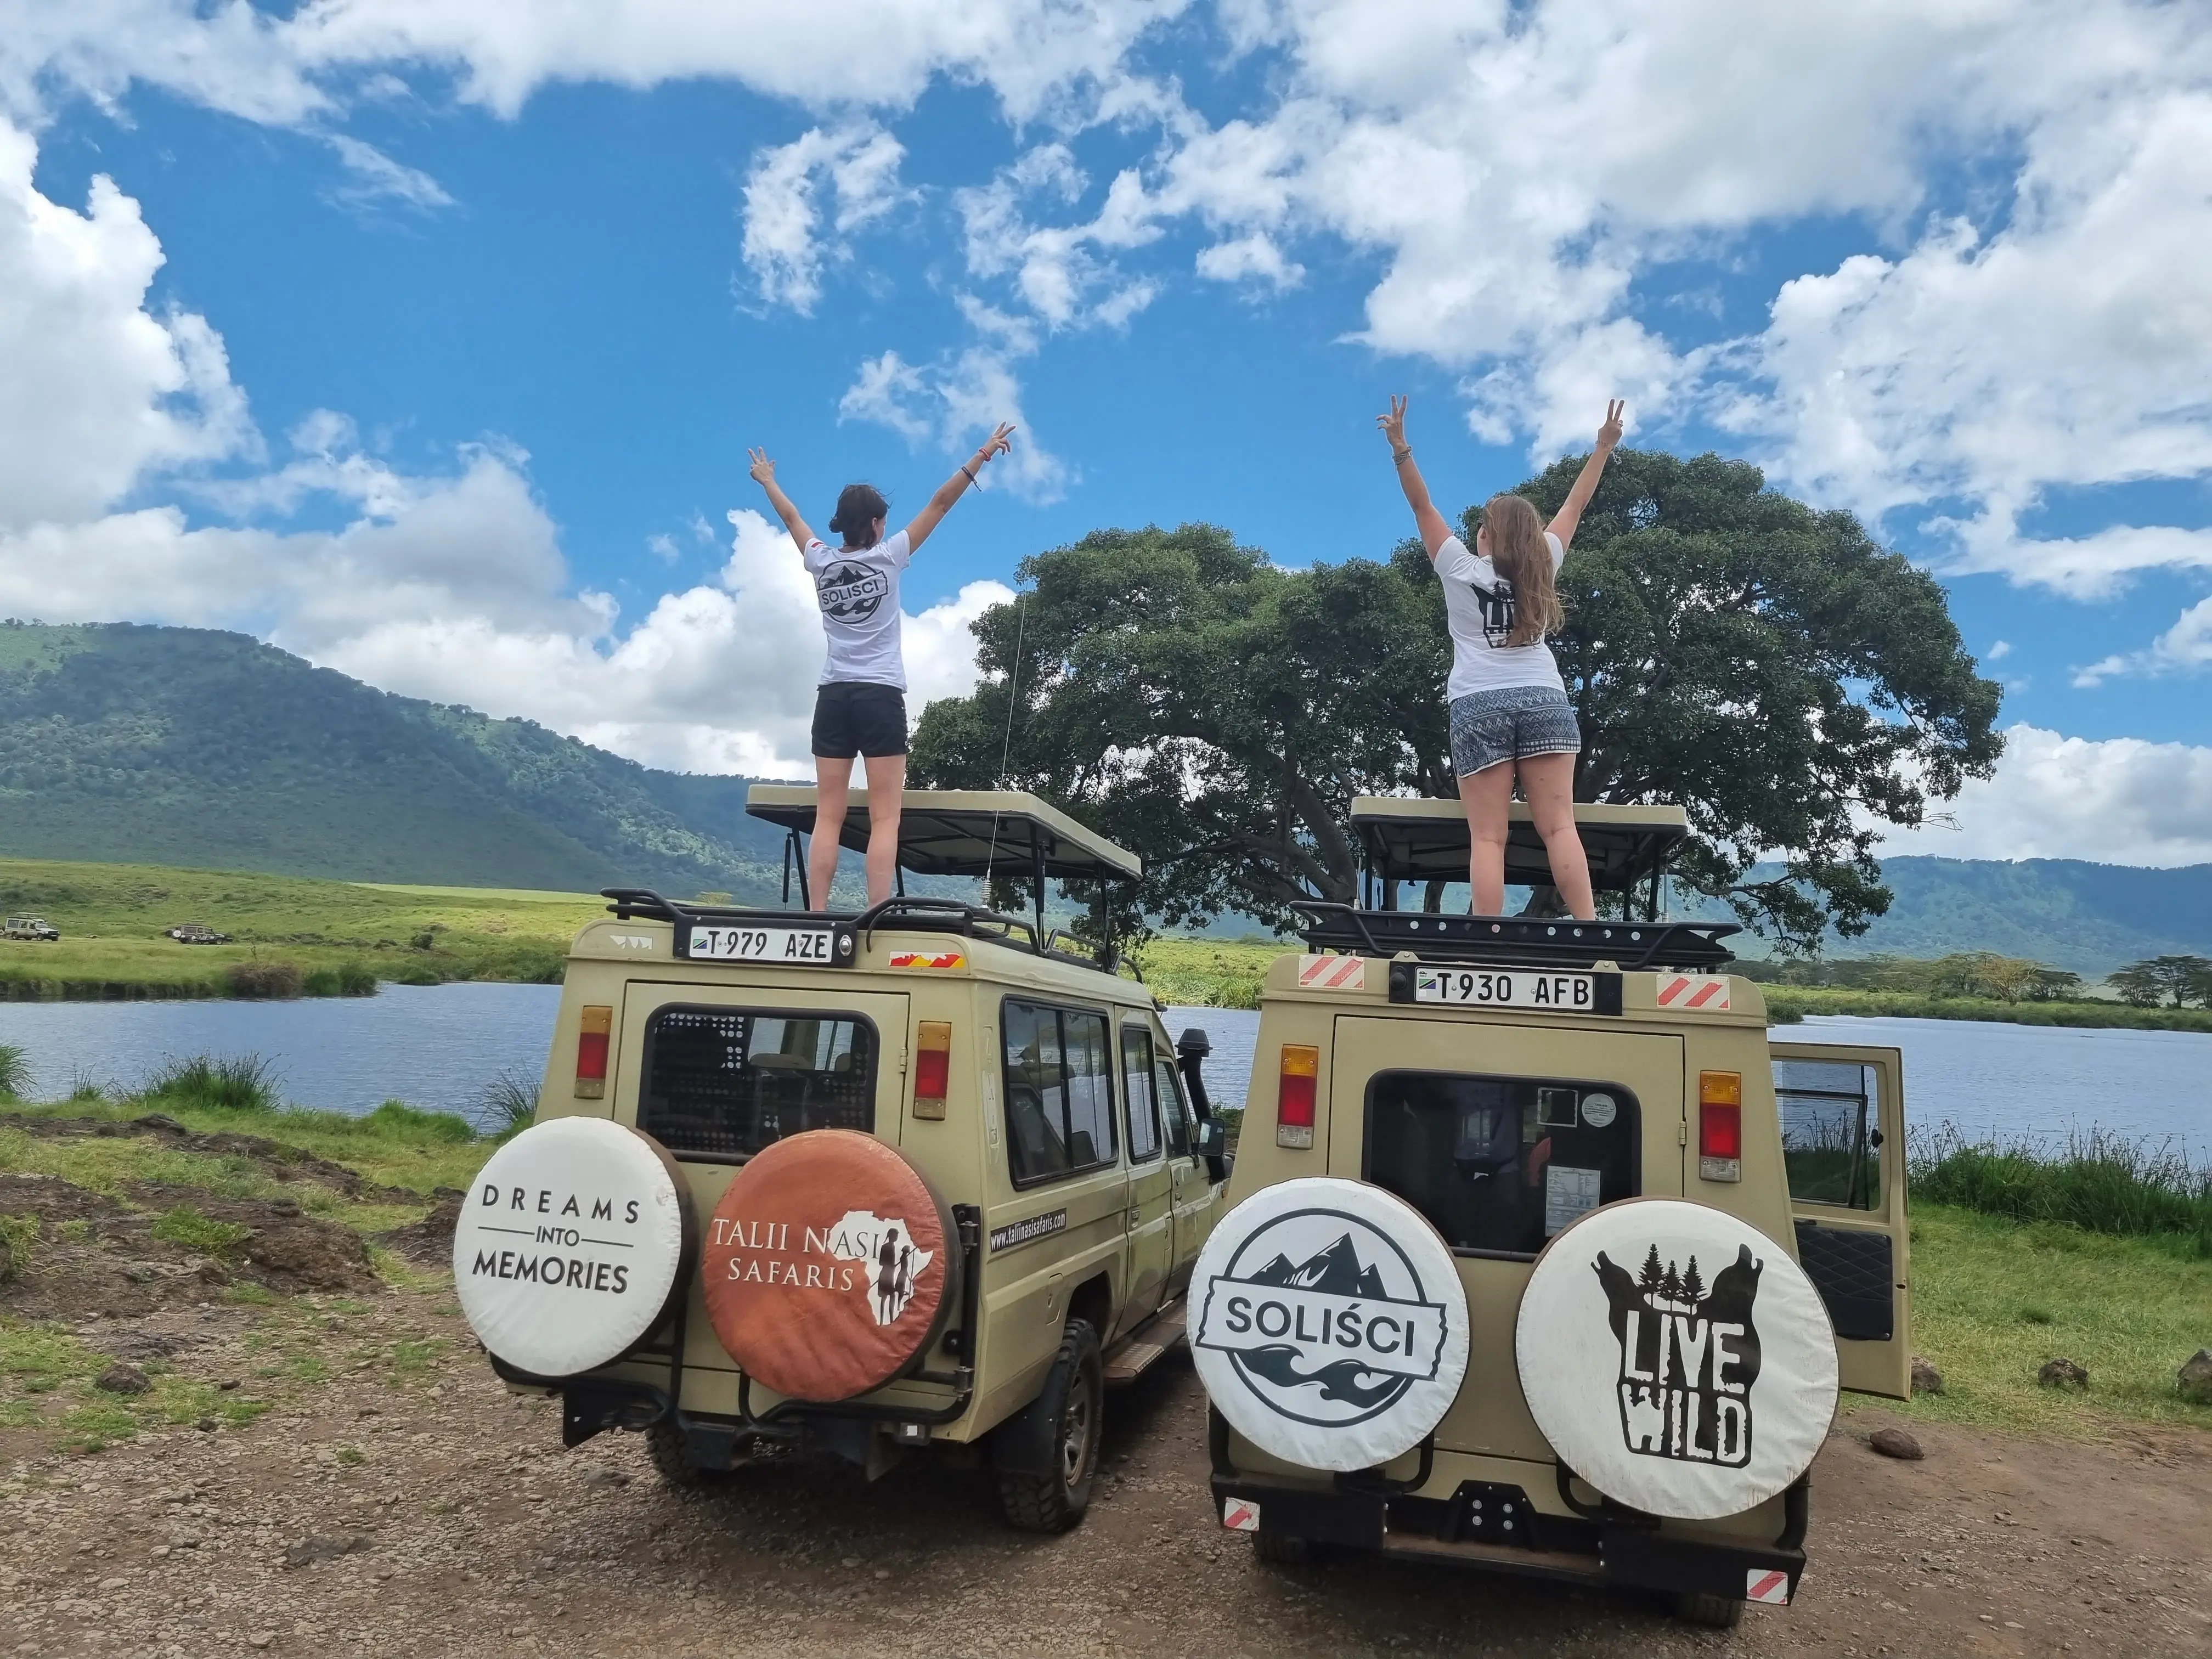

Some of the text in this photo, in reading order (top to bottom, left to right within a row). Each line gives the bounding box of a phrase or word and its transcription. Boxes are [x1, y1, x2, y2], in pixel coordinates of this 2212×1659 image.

[785, 933, 828, 958] AZE
[1535, 977, 1589, 1005] AFB
[482, 1184, 640, 1224] DREAMS
[535, 1225, 580, 1247] INTO
[713, 1218, 880, 1260] TALII NASI
[991, 1213, 1065, 1251] www.taliinasisafaris.com
[472, 1248, 630, 1294] MEMORIES
[727, 1257, 854, 1291] SAFARIS
[1225, 1296, 1415, 1357] SOLIŚCI
[1624, 1309, 1745, 1395] LIVE
[1621, 1383, 1746, 1464] WILD
